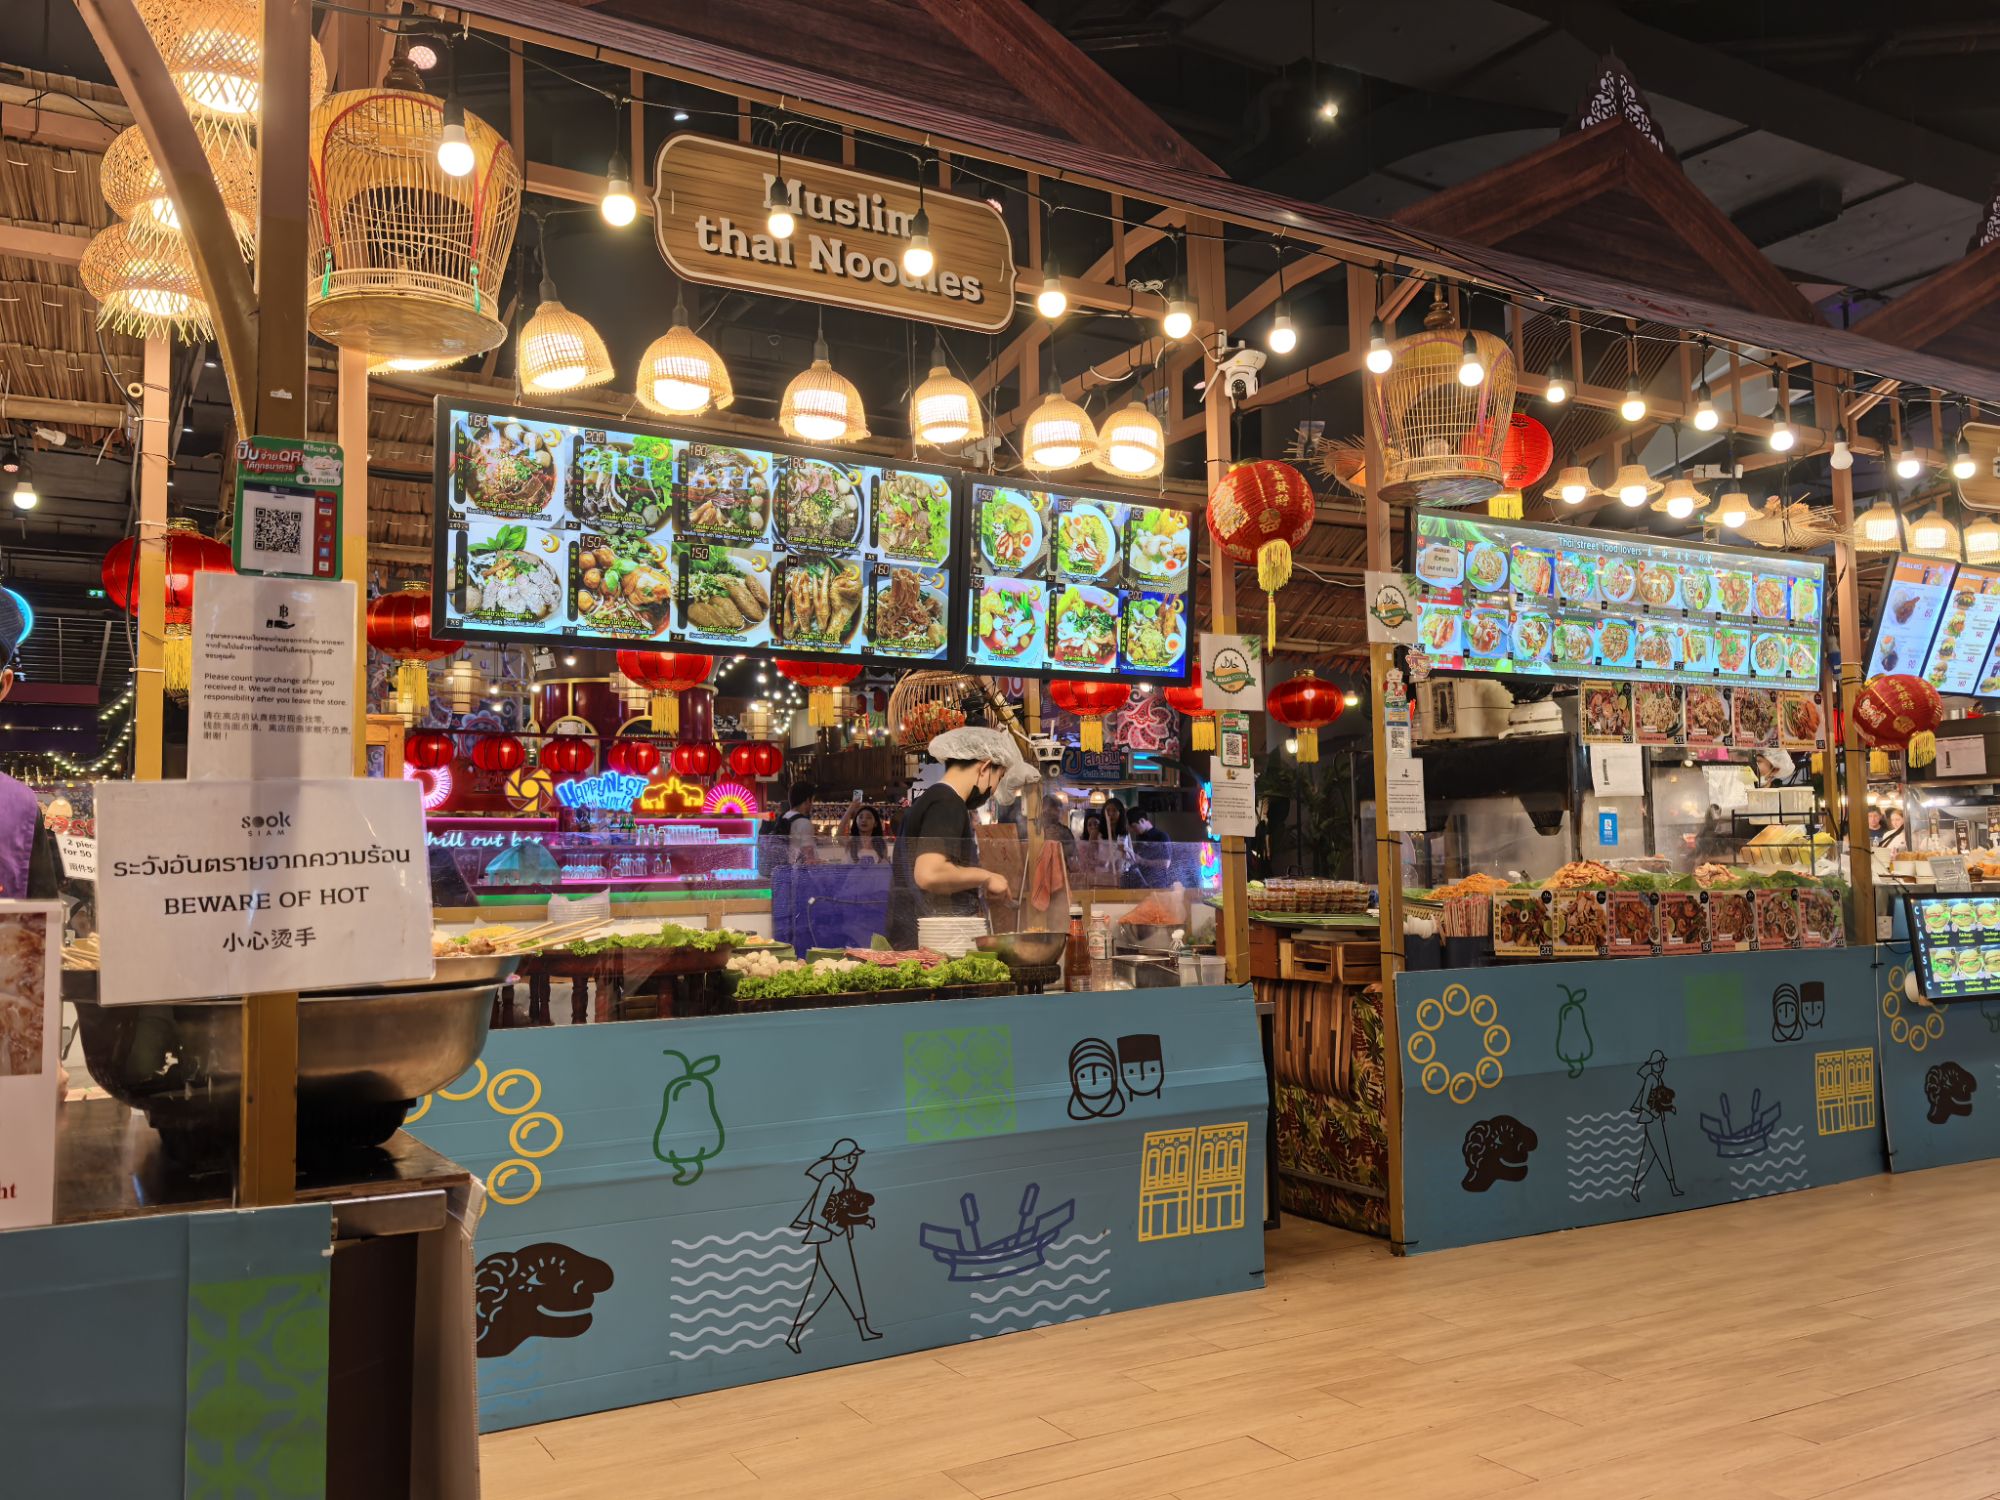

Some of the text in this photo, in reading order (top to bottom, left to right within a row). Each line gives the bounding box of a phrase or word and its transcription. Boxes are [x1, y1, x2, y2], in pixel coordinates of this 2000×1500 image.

[762, 172, 917, 240] Muslim
[695, 214, 795, 266] thai
[469, 415, 488, 428] 180
[586, 431, 605, 444] 200
[279, 450, 300, 462] QR
[691, 445, 706, 457] 180
[582, 536, 600, 548] 150
[1558, 536, 1574, 548] Thai
[1576, 539, 1600, 550] street
[1602, 542, 1618, 553] food
[1620, 544, 1643, 556] lovers
[692, 547, 708, 560] 150
[204, 673, 229, 681] Please
[254, 676, 272, 684] your
[273, 677, 300, 686] change
[302, 678, 319, 686] after
[321, 679, 335, 687] you
[204, 683, 237, 692] received
[262, 685, 276, 693] will
[292, 687, 308, 695] take
[309, 689, 323, 697] any
[204, 693, 348, 707] responsibility after you leave the store.
[241, 811, 291, 829] sook
[471, 834, 505, 847] out
[63, 847, 92, 858] for 50
[113, 844, 411, 878] ระวังอันตรายจากความร้อน
[164, 886, 370, 916] BEWARE OF HOT
[222, 926, 317, 953] 小心烫手
[1914, 906, 1932, 990] CLASSIC
